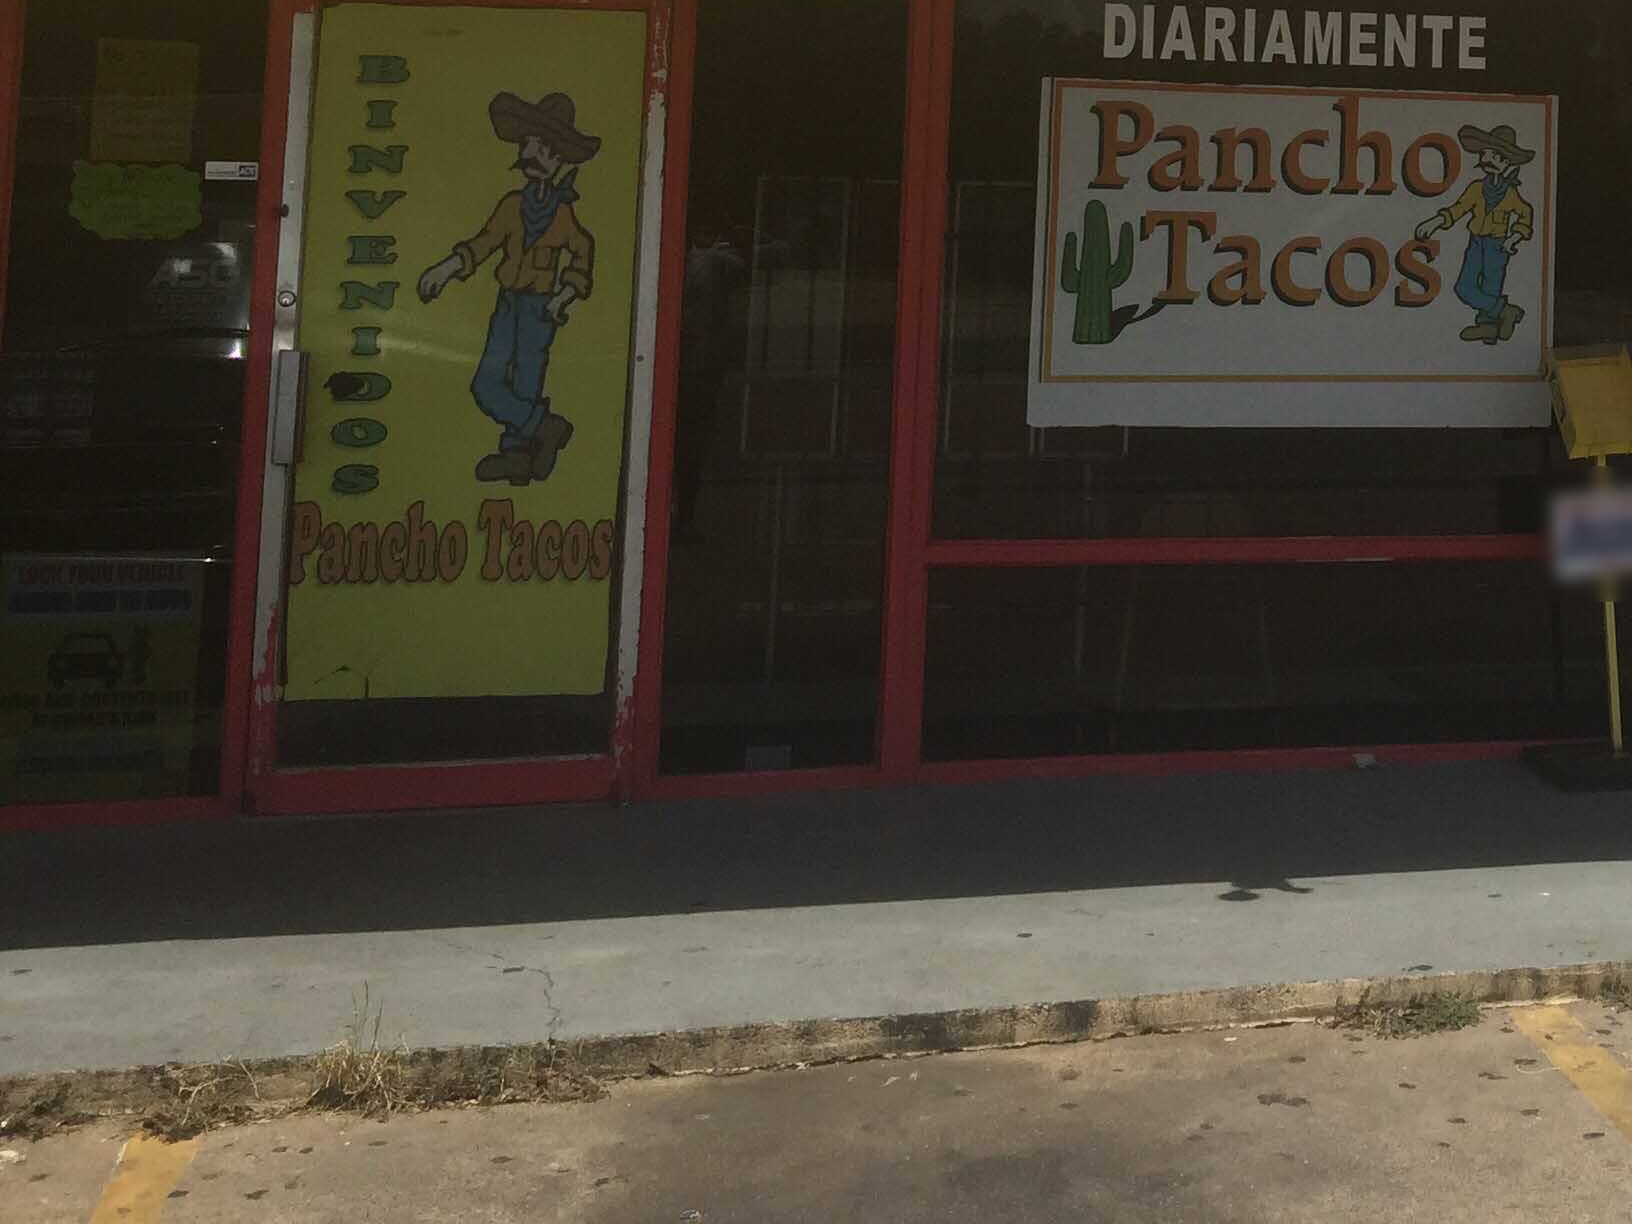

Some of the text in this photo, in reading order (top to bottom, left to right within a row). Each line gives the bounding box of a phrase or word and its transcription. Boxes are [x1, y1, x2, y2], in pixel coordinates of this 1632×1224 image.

[1102, 2, 1488, 70] DIARIAMENTE
[1088, 96, 1463, 197] Pancho
[1140, 210, 1443, 307] Tacos
[289, 498, 613, 584] Pancho Tacos
